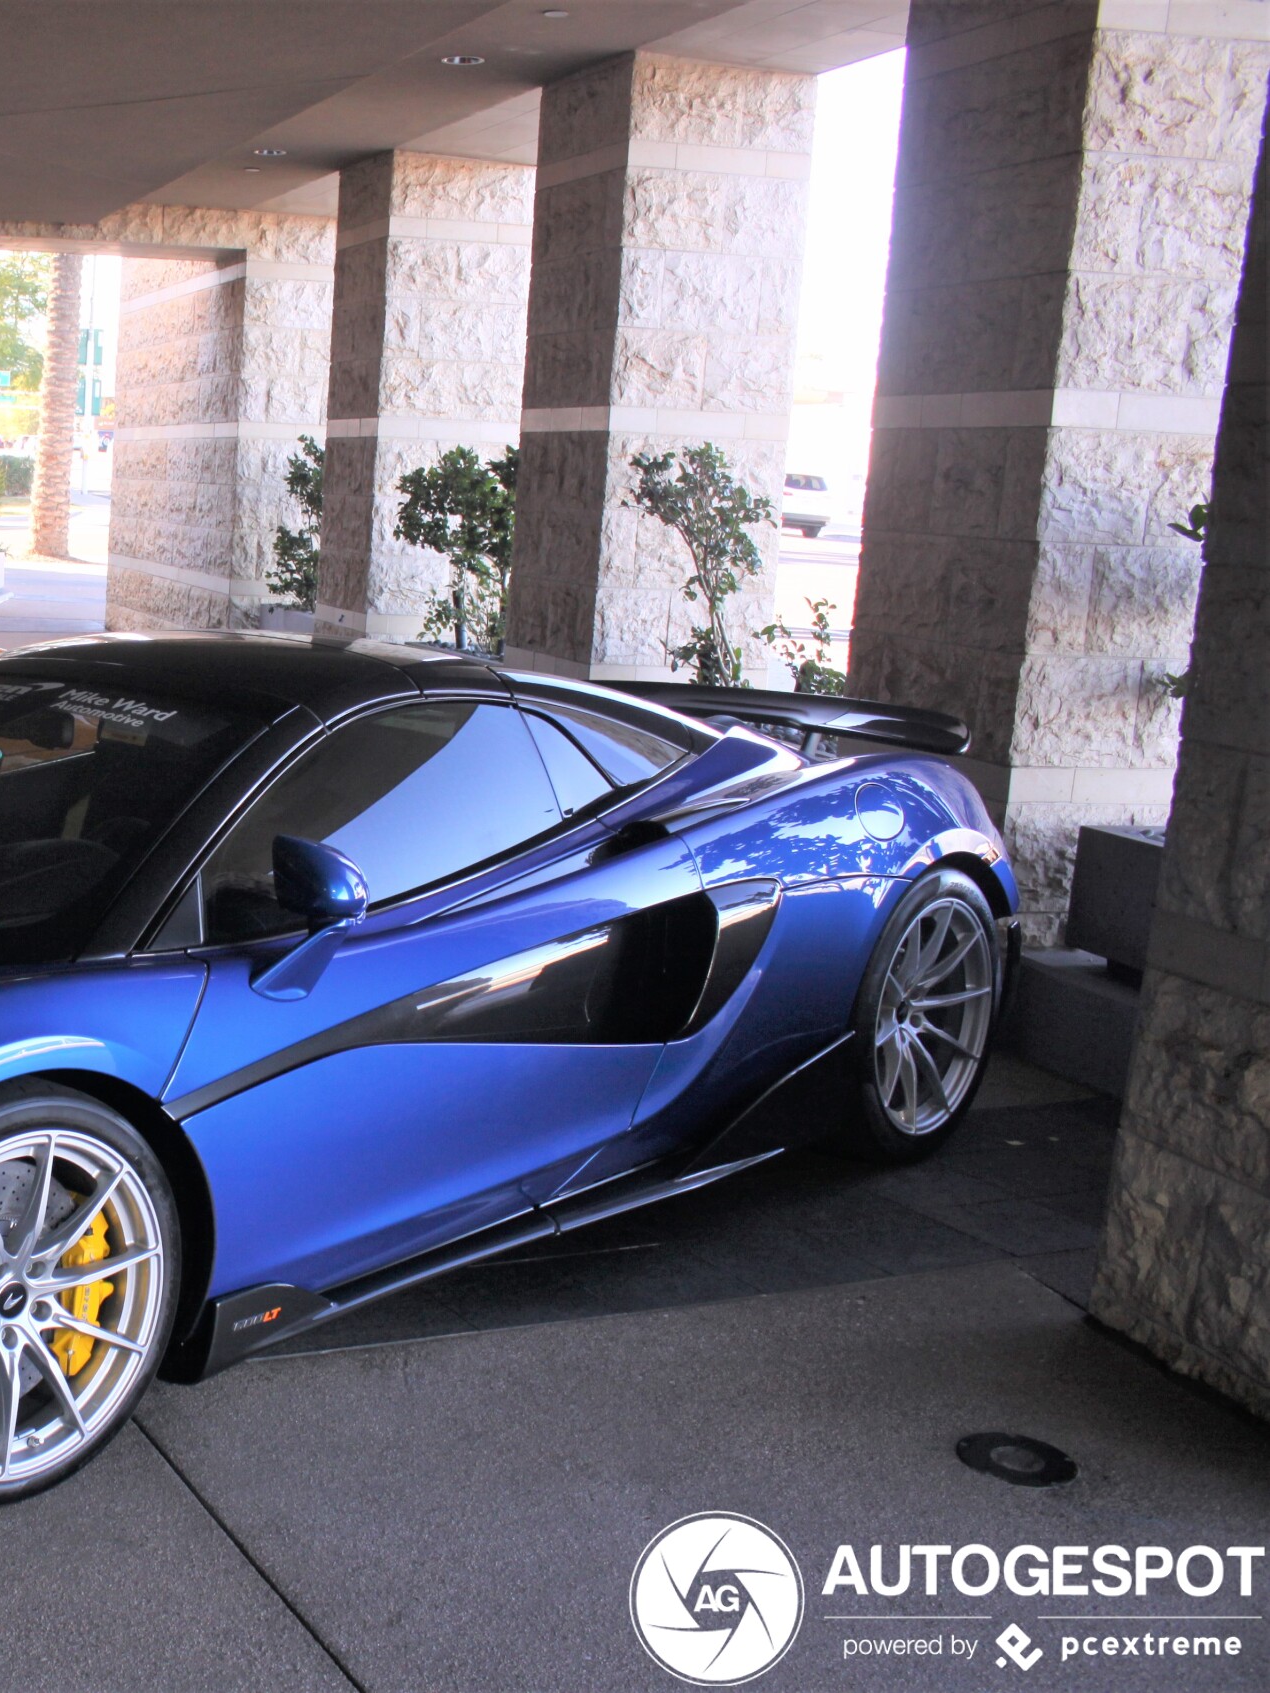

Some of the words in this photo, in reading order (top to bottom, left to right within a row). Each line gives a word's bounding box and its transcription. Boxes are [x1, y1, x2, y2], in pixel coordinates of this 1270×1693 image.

[50, 699, 146, 728] Automotive
[58, 688, 111, 706] Mike
[111, 697, 178, 722] Ward
